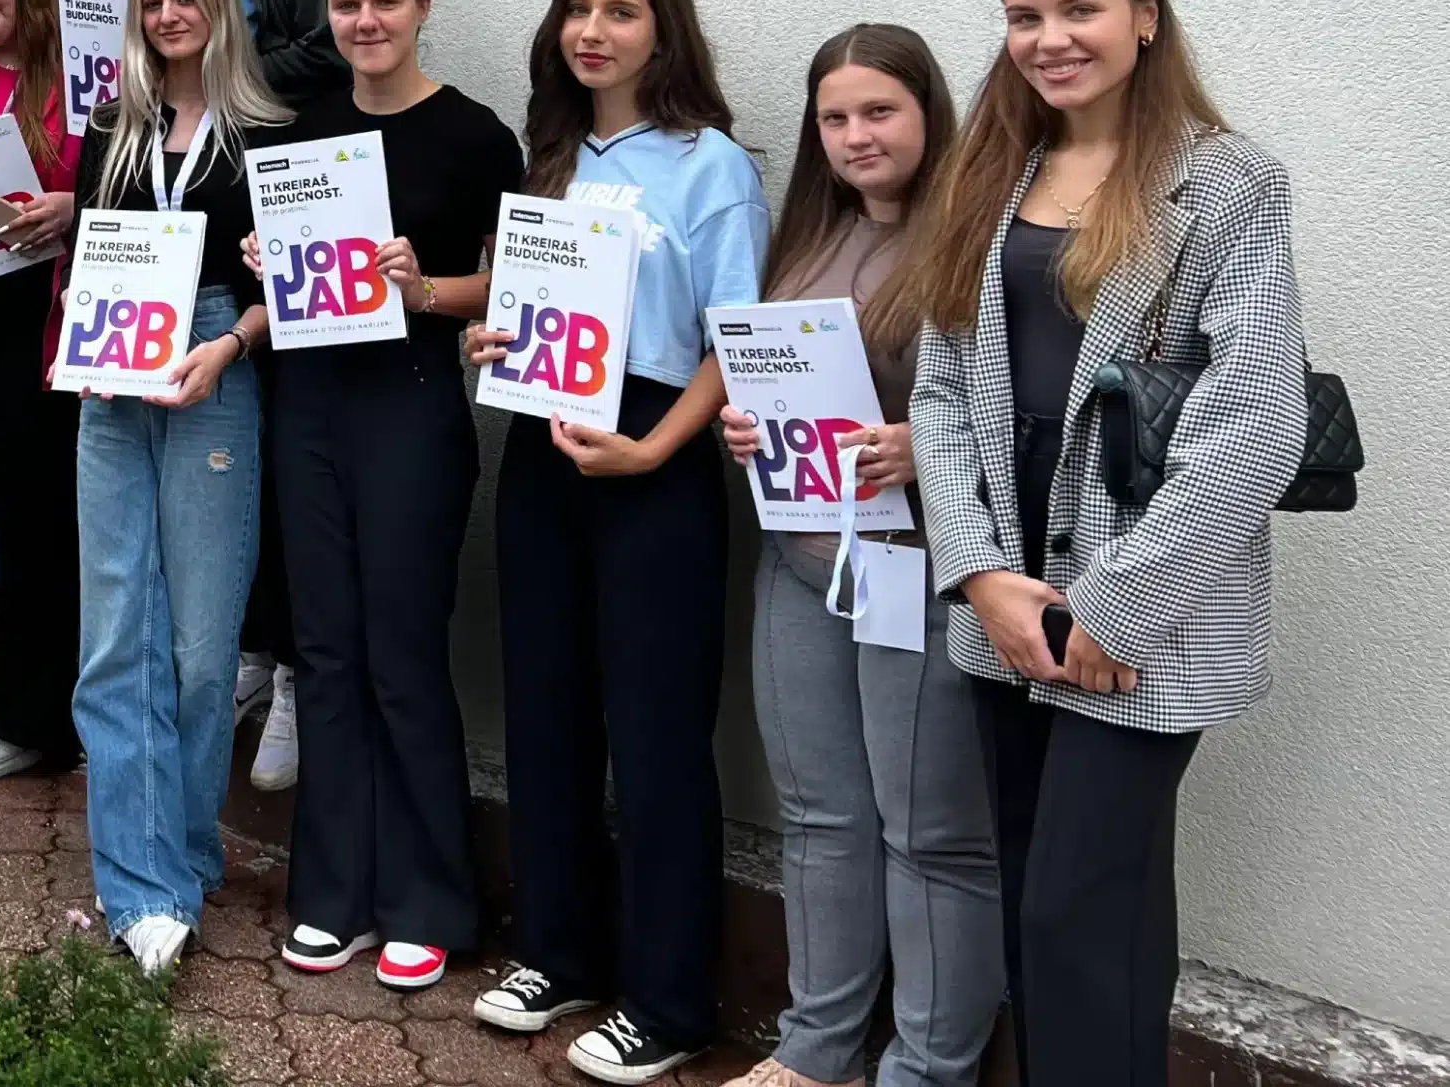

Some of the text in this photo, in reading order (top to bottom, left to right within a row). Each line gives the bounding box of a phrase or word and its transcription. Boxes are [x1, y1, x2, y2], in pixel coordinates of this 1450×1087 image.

[65, 0, 112, 13] TI KREIRAŠ
[66, 10, 121, 26] BUDUĆNOST.
[259, 161, 287, 171] telemach
[259, 173, 329, 195] TI KREIRAŠ
[261, 187, 343, 208] BUDUĆNOST.
[85, 241, 151, 253] TI KREIRAŠ
[507, 232, 578, 254] TI KREIRAŠ
[83, 252, 160, 265] BUDUĆNOST.
[273, 237, 387, 295] JOB
[504, 246, 588, 270] BUDUĆNOST.
[273, 264, 388, 323] LAB
[71, 299, 177, 342] JOB
[495, 303, 609, 354] JOB
[66, 320, 176, 371] LAB
[724, 344, 797, 359] TI KREIRAŠ
[490, 331, 608, 397] LAB
[729, 359, 814, 373] BUDUĆNOST.
